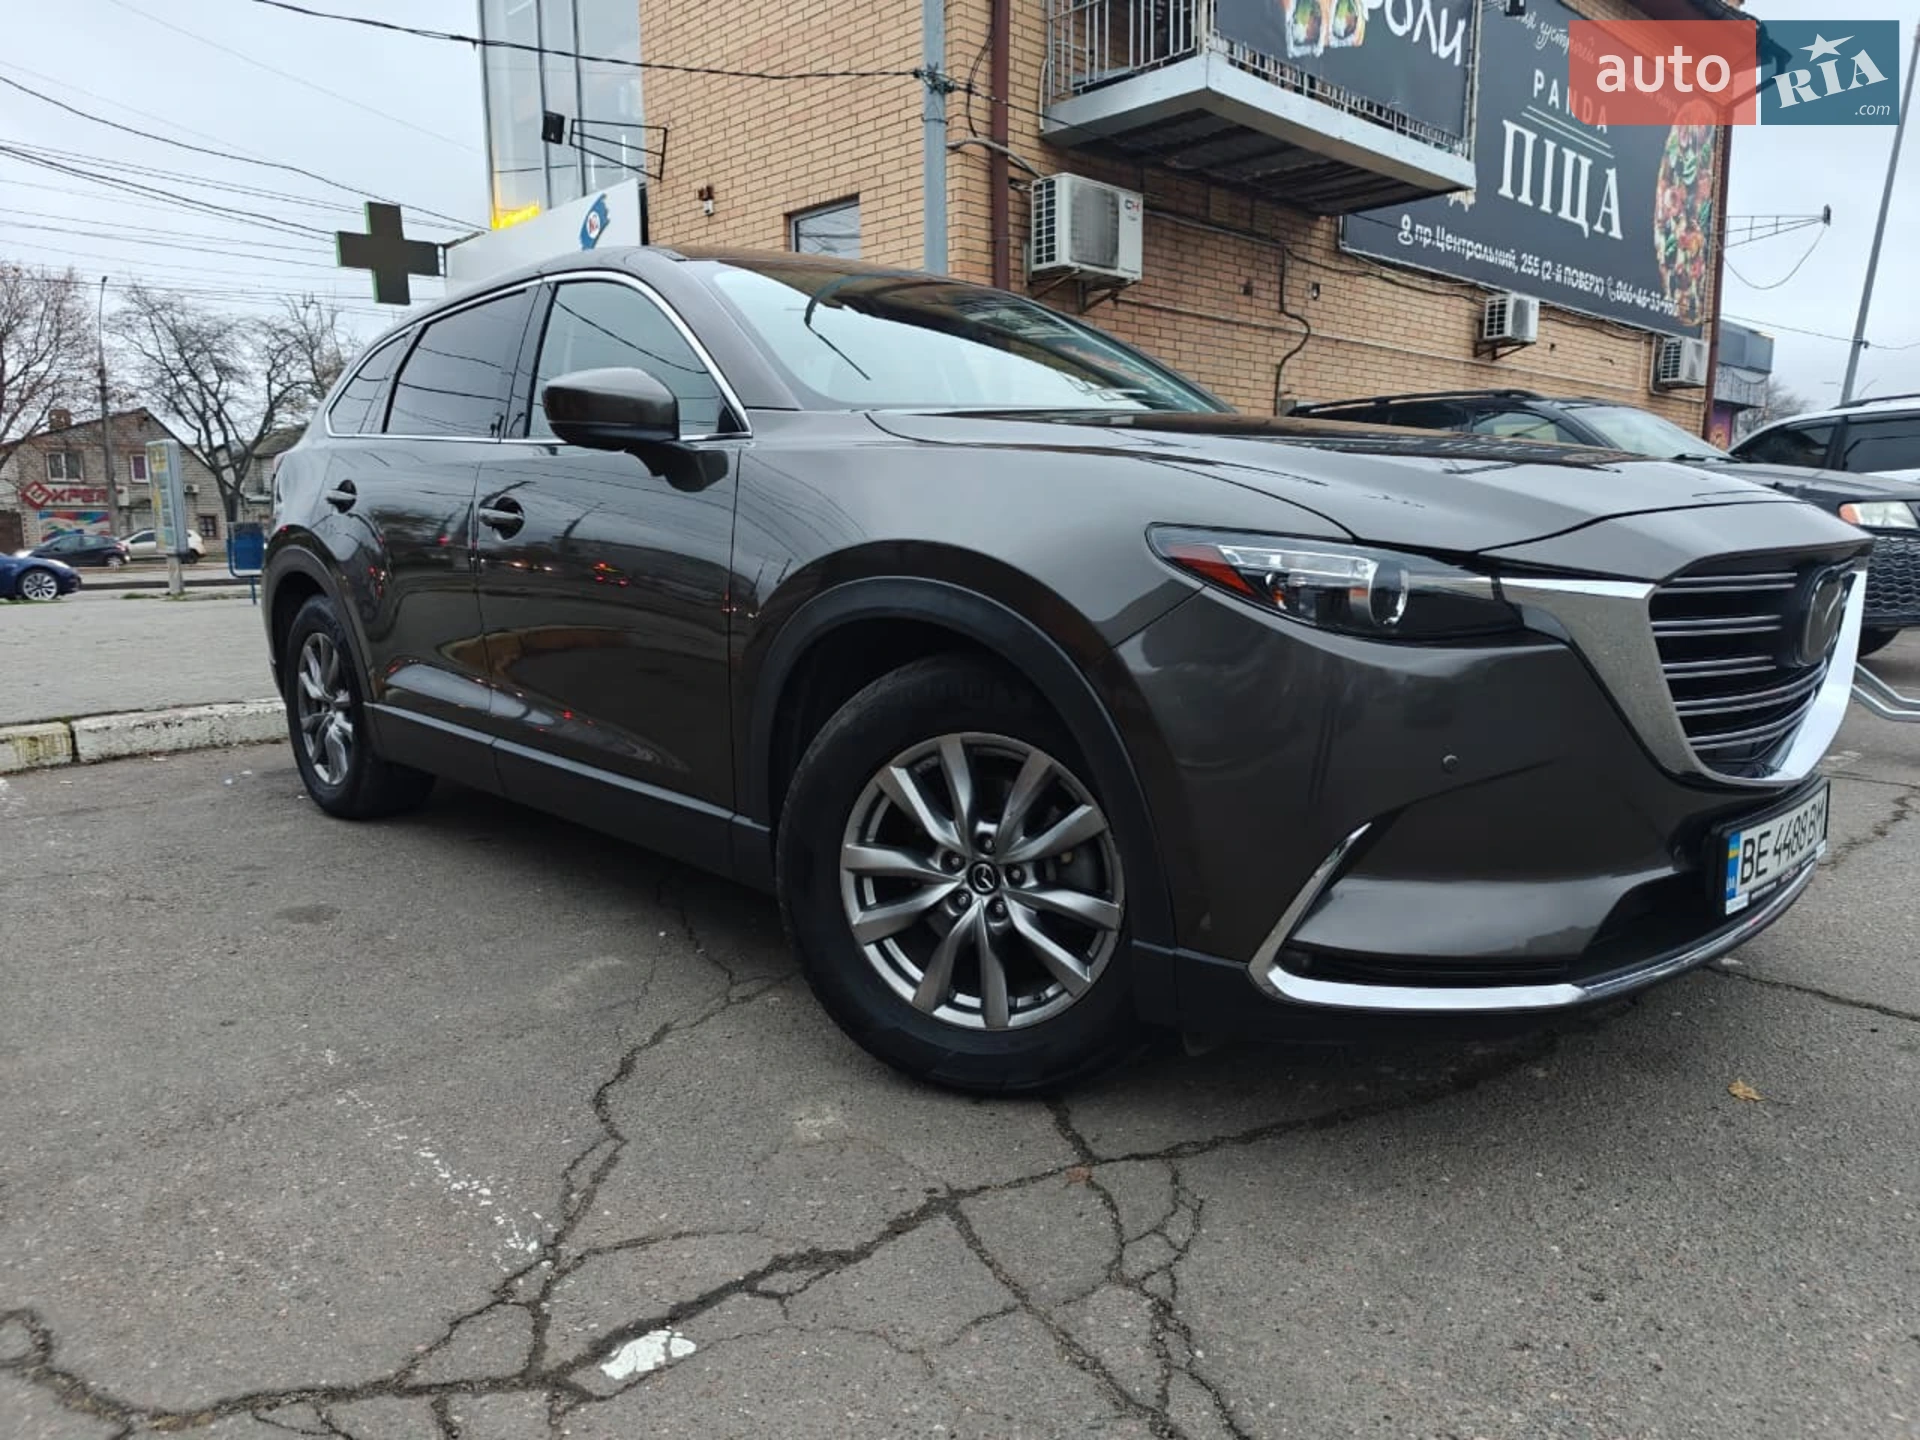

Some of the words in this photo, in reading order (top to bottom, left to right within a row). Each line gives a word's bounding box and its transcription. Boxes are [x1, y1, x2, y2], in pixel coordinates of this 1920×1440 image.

[1533, 68, 1608, 134] PANDA
[1497, 119, 1624, 240] ПІЦА
[1520, 253, 1541, 277] 255
[1740, 830, 1771, 886] BE
